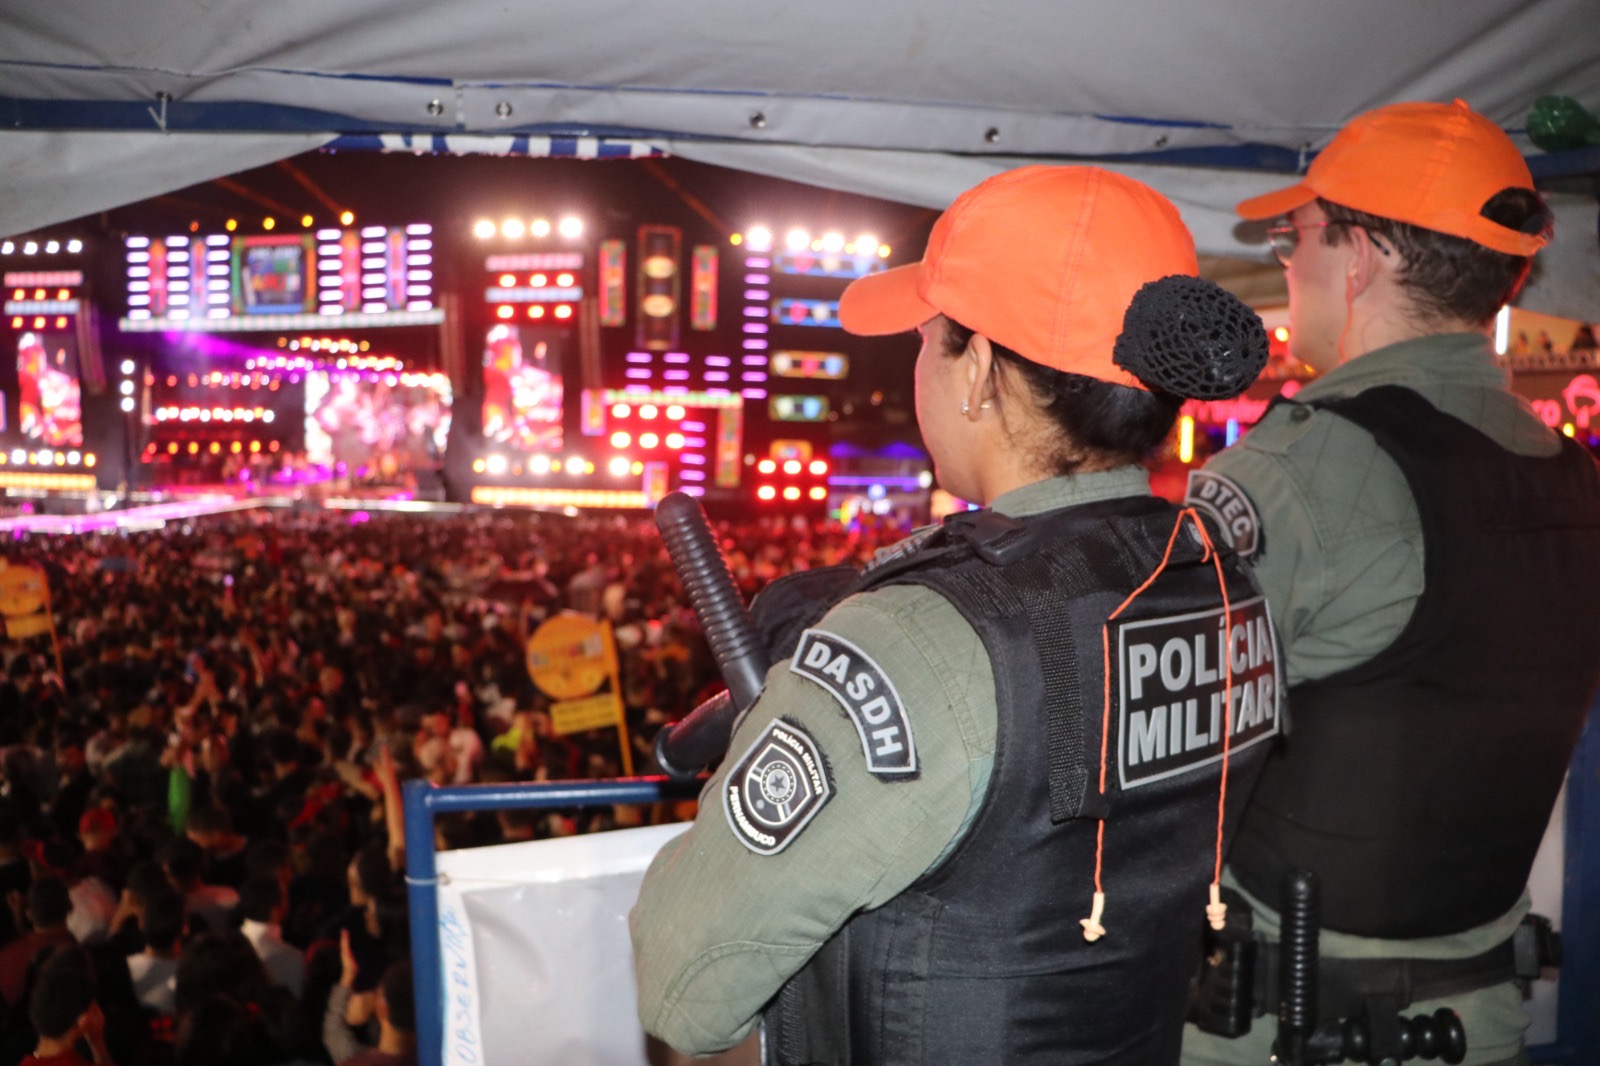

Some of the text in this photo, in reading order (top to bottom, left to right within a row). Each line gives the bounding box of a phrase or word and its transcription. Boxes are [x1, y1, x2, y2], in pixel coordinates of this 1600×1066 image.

[1200, 480, 1251, 537] DTEC
[1128, 615, 1272, 700] POLÍCIA
[804, 641, 903, 756] DASDH
[1128, 673, 1274, 766] MILITAR
[772, 728, 823, 795] POLÍCIA MILITAR
[729, 786, 776, 847] PERNAMBUCO
